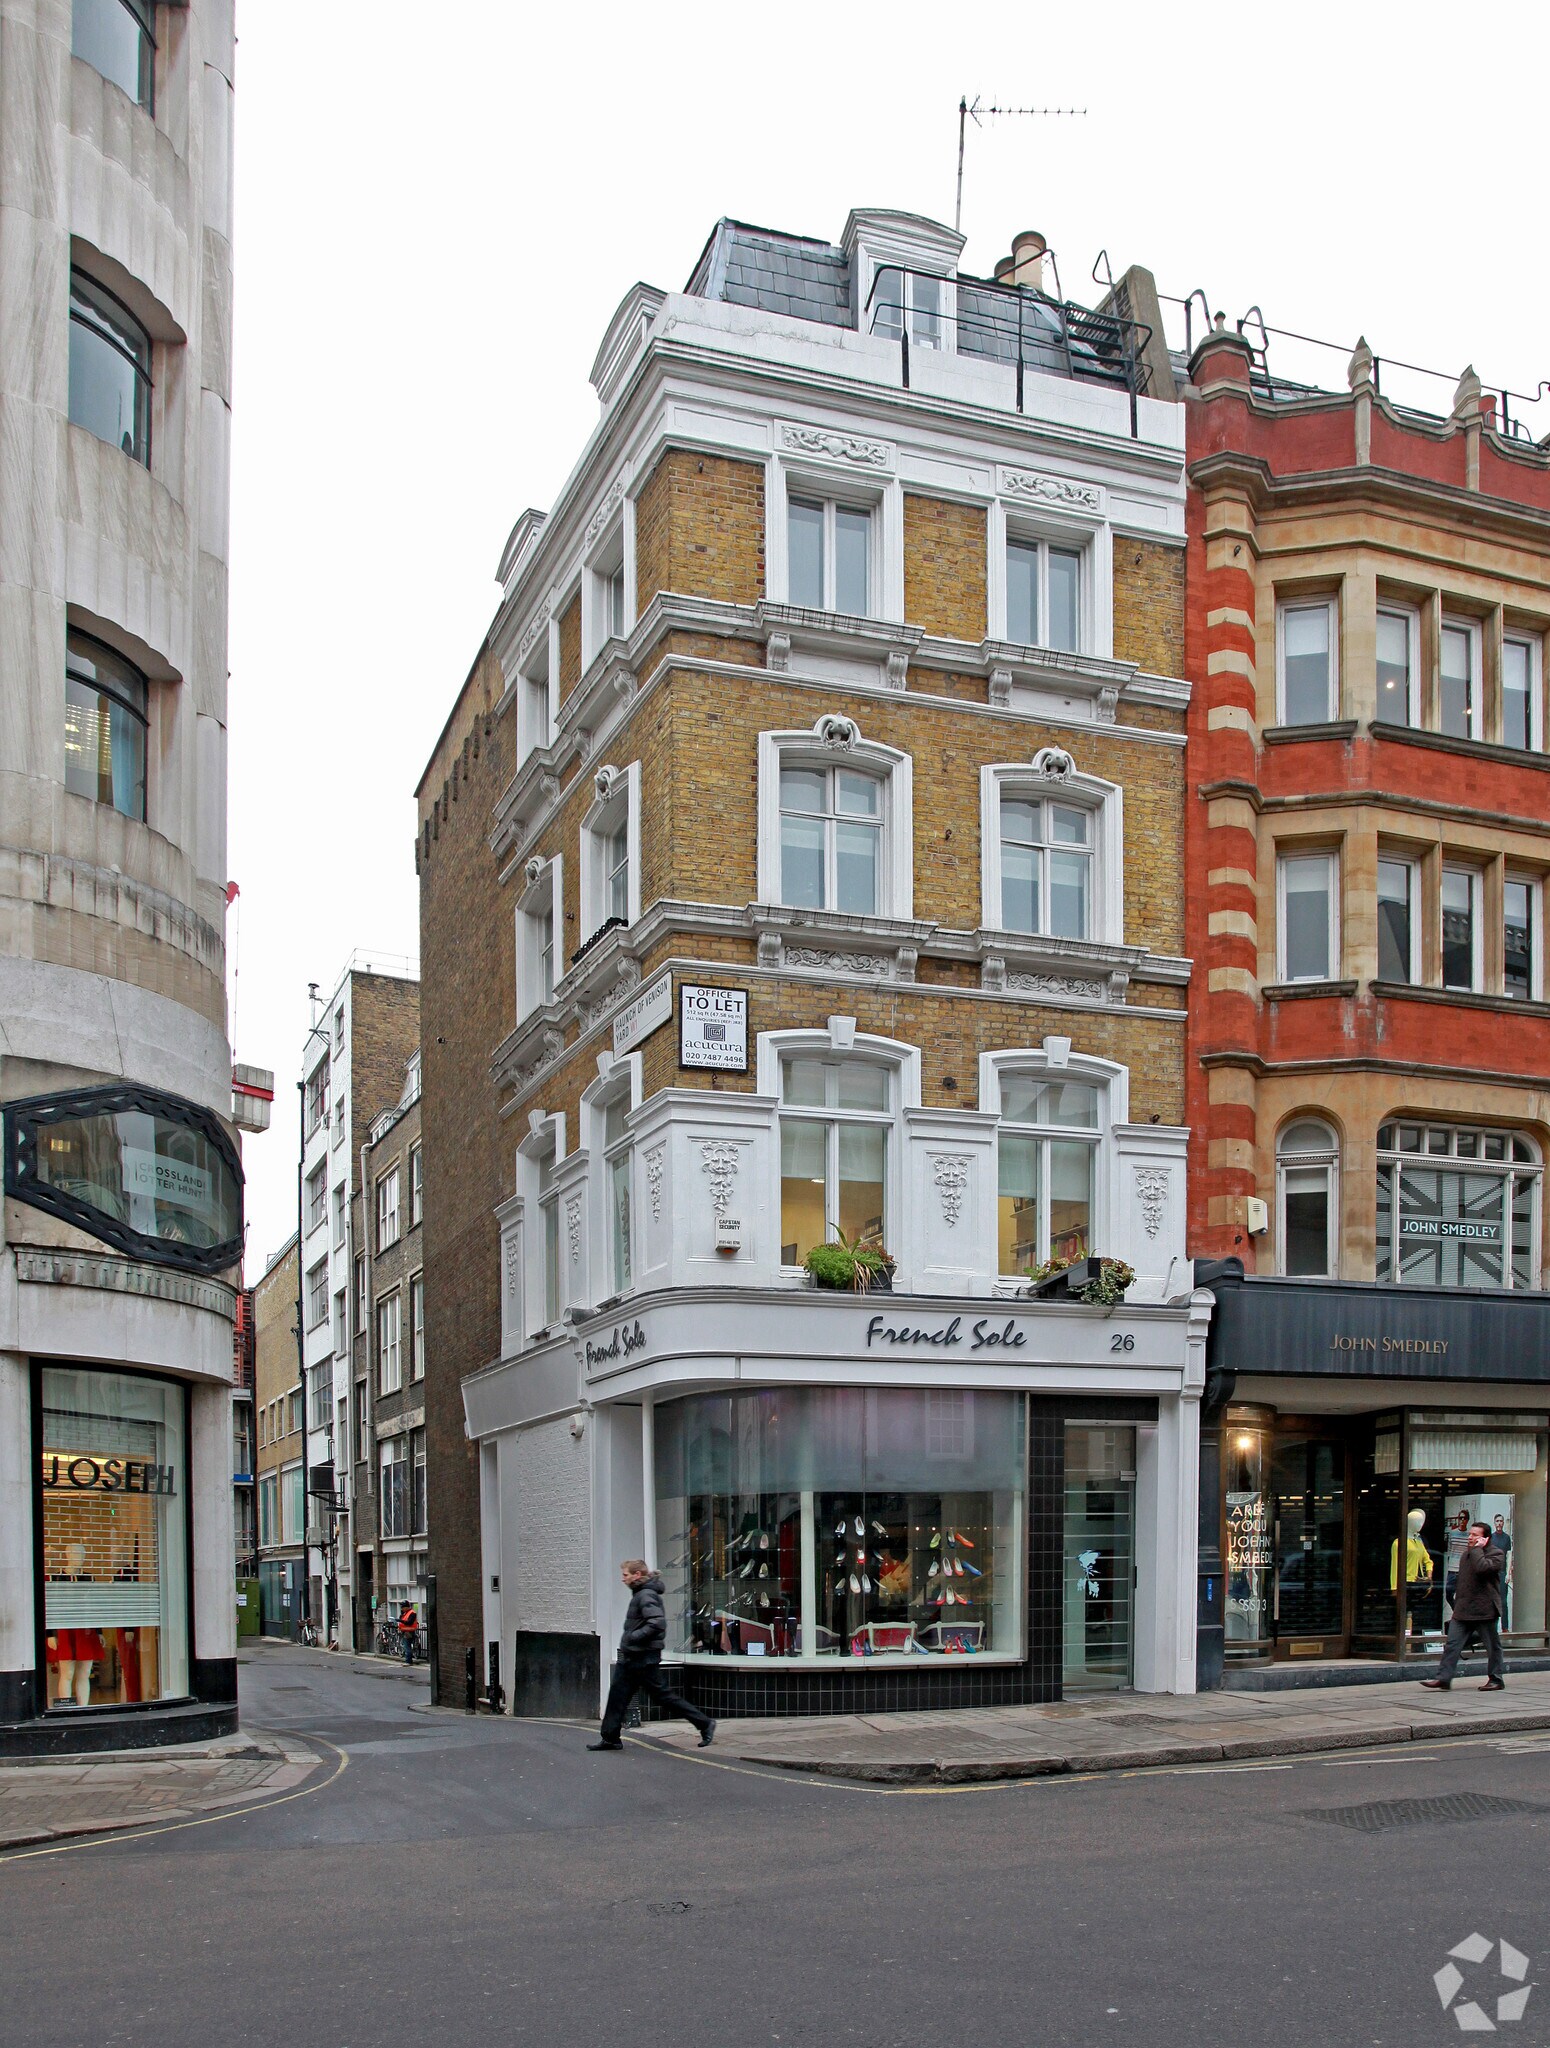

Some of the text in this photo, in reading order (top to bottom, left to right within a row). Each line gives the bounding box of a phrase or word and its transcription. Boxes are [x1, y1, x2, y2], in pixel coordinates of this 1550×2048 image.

[697, 988, 732, 999] OFFICE
[615, 979, 668, 1032] HAUNCH OF VENISON
[685, 995, 743, 1012] TO LET
[615, 1026, 630, 1045] YARD
[685, 1039, 743, 1052] acucura
[685, 1059, 744, 1068] www.acucura.com
[702, 1053, 722, 1061] 7487
[724, 1055, 744, 1063] 4496
[139, 1162, 203, 1188] CROSSLAND
[139, 1174, 203, 1198] OTTER HUNT
[1402, 1220, 1497, 1238] JOHN SMEDLEY
[866, 1316, 1135, 1351] French Sole 26
[586, 1320, 647, 1371] French Sole
[1330, 1334, 1449, 1354] JOHN SMEDLEY
[43, 1456, 174, 1492] JOSEPH
